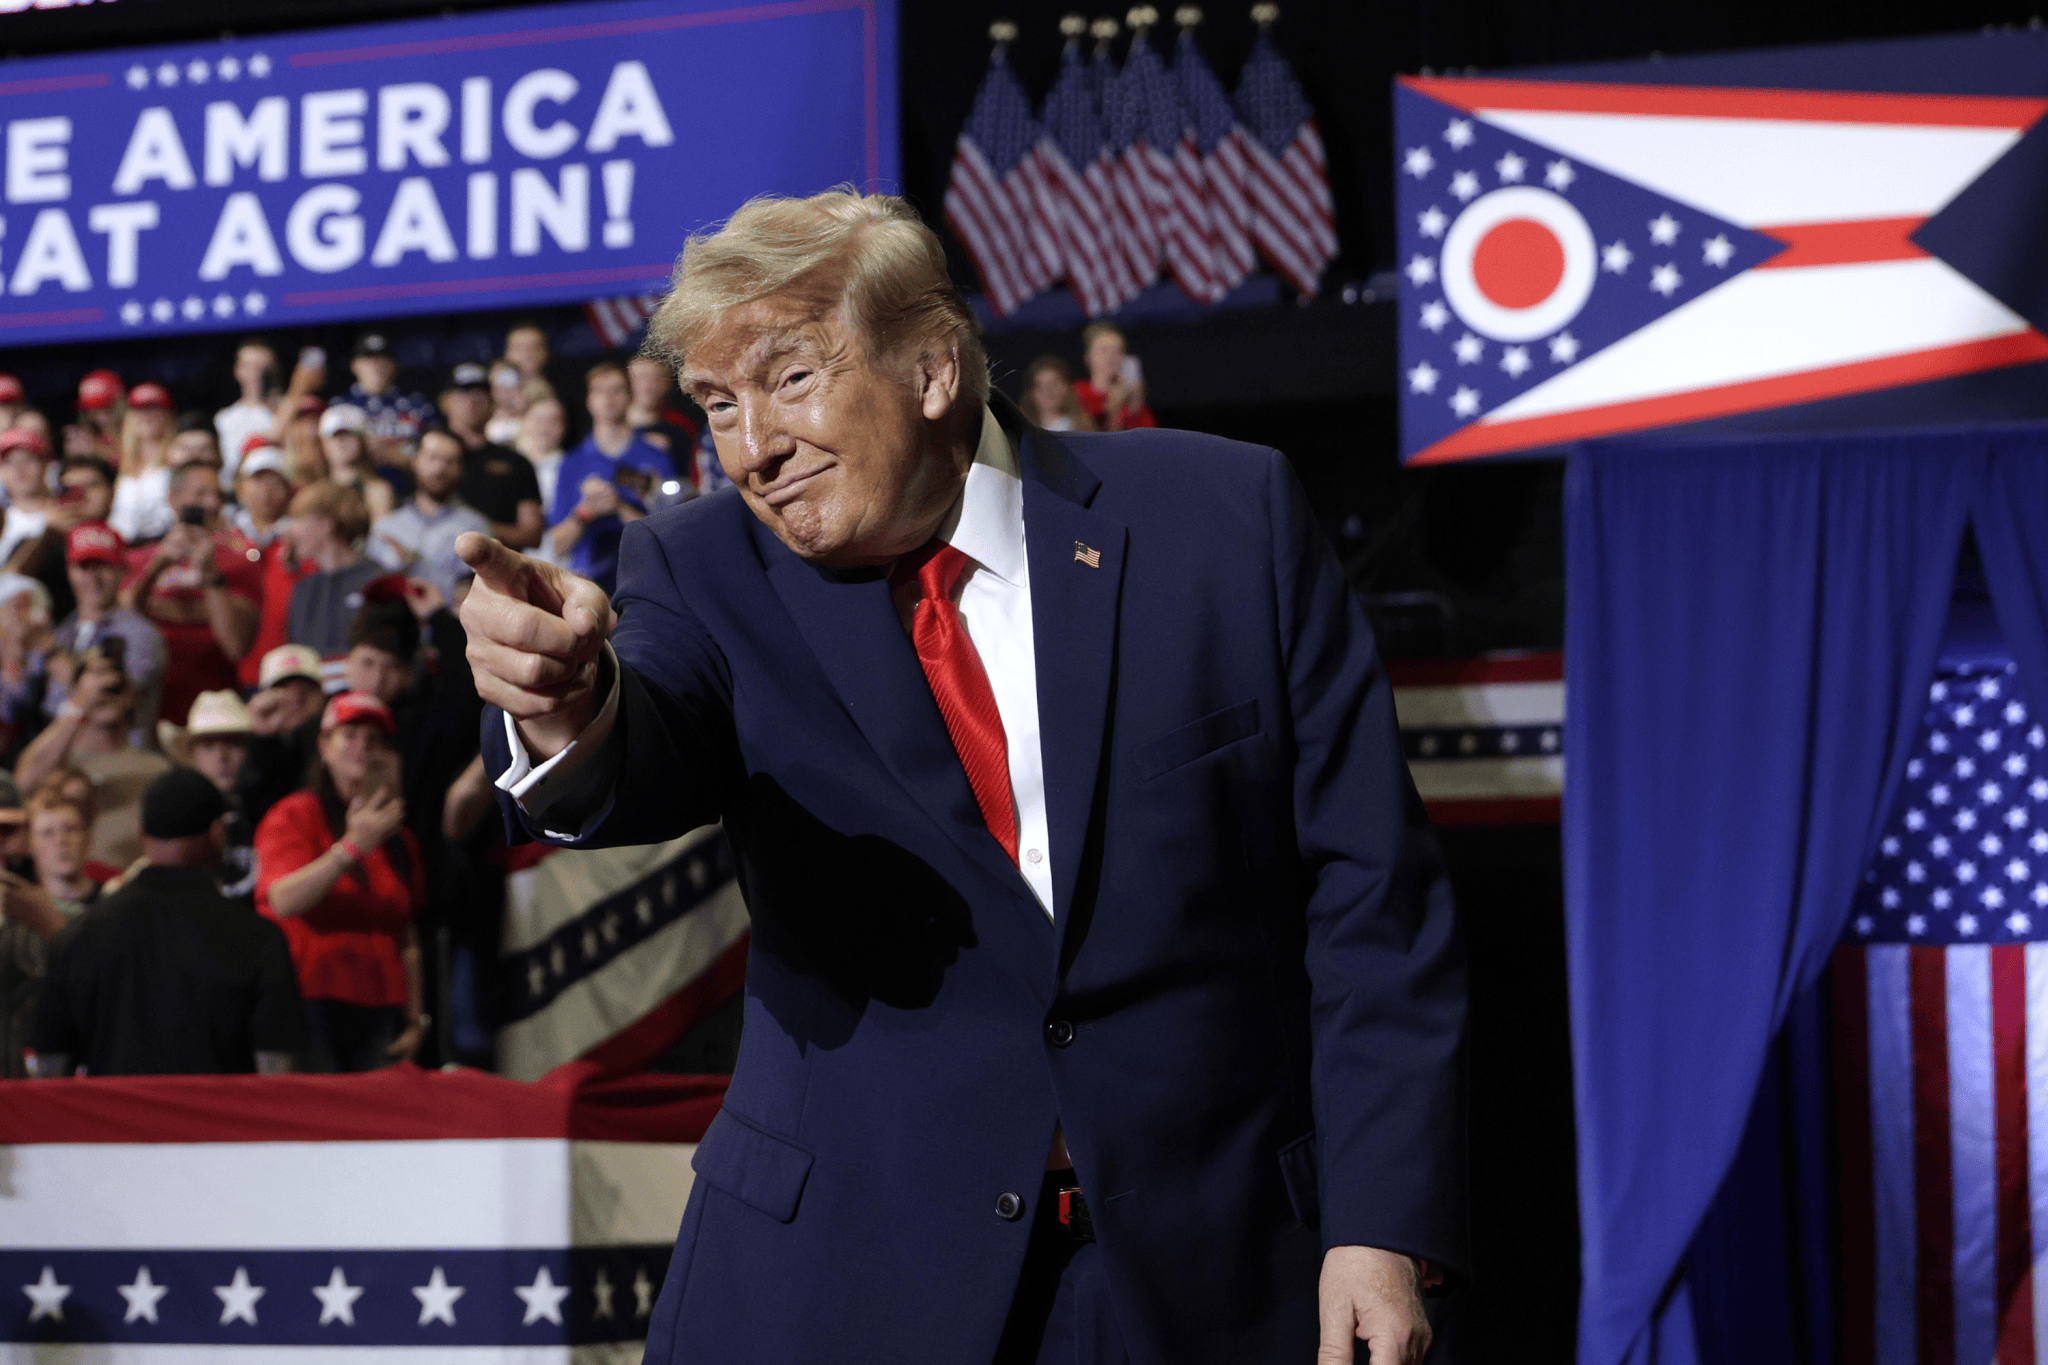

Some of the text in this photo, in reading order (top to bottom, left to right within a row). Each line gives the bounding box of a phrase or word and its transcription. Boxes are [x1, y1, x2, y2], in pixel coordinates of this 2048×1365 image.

[112, 60, 674, 195] AMERICA
[0, 158, 635, 296] AT AGAIN!
